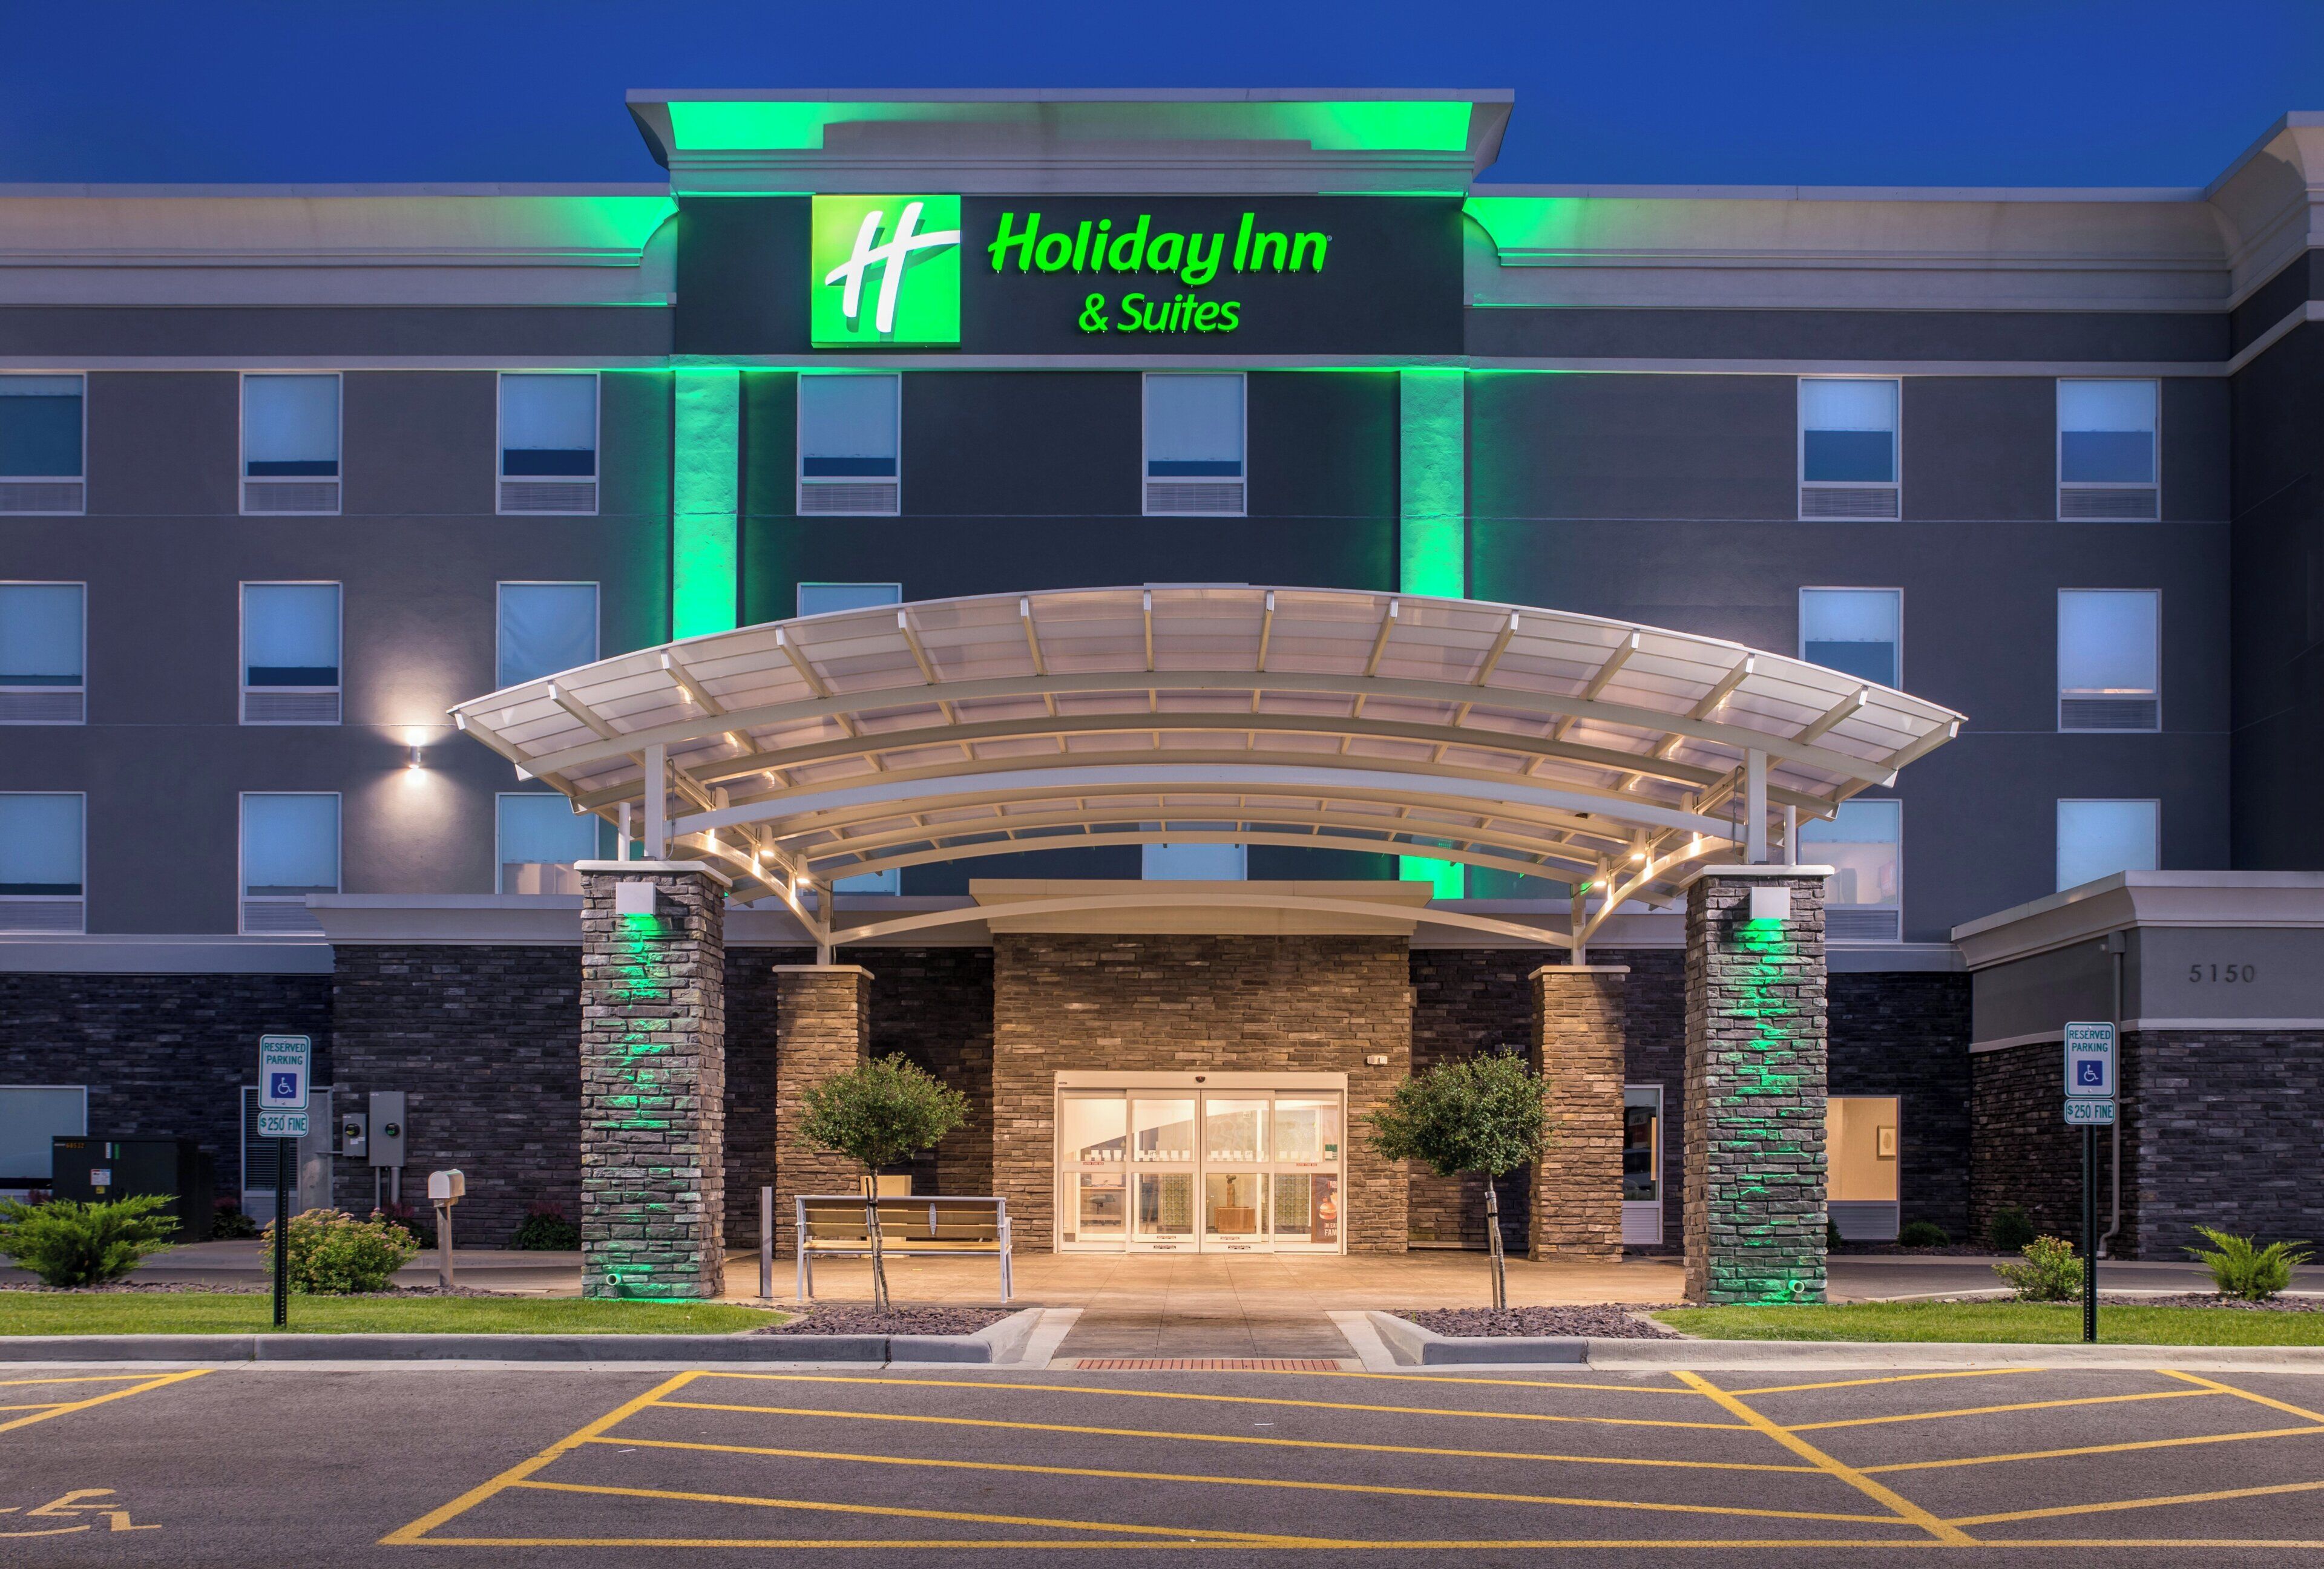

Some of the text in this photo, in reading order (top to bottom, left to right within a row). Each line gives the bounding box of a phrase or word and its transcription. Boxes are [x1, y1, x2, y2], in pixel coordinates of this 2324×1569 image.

[988, 213, 1327, 285] Holiday Inn
[1079, 293, 1241, 332] & Suites
[2189, 963, 2255, 983] 5150
[2069, 1030, 2111, 1040] RESERVED
[264, 1043, 306, 1053] RESERVED
[2072, 1043, 2109, 1052] PARKING
[266, 1055, 303, 1065] PARKING
[2067, 1104, 2113, 1119] $250 FINE
[260, 1117, 306, 1132] $250 FINE
